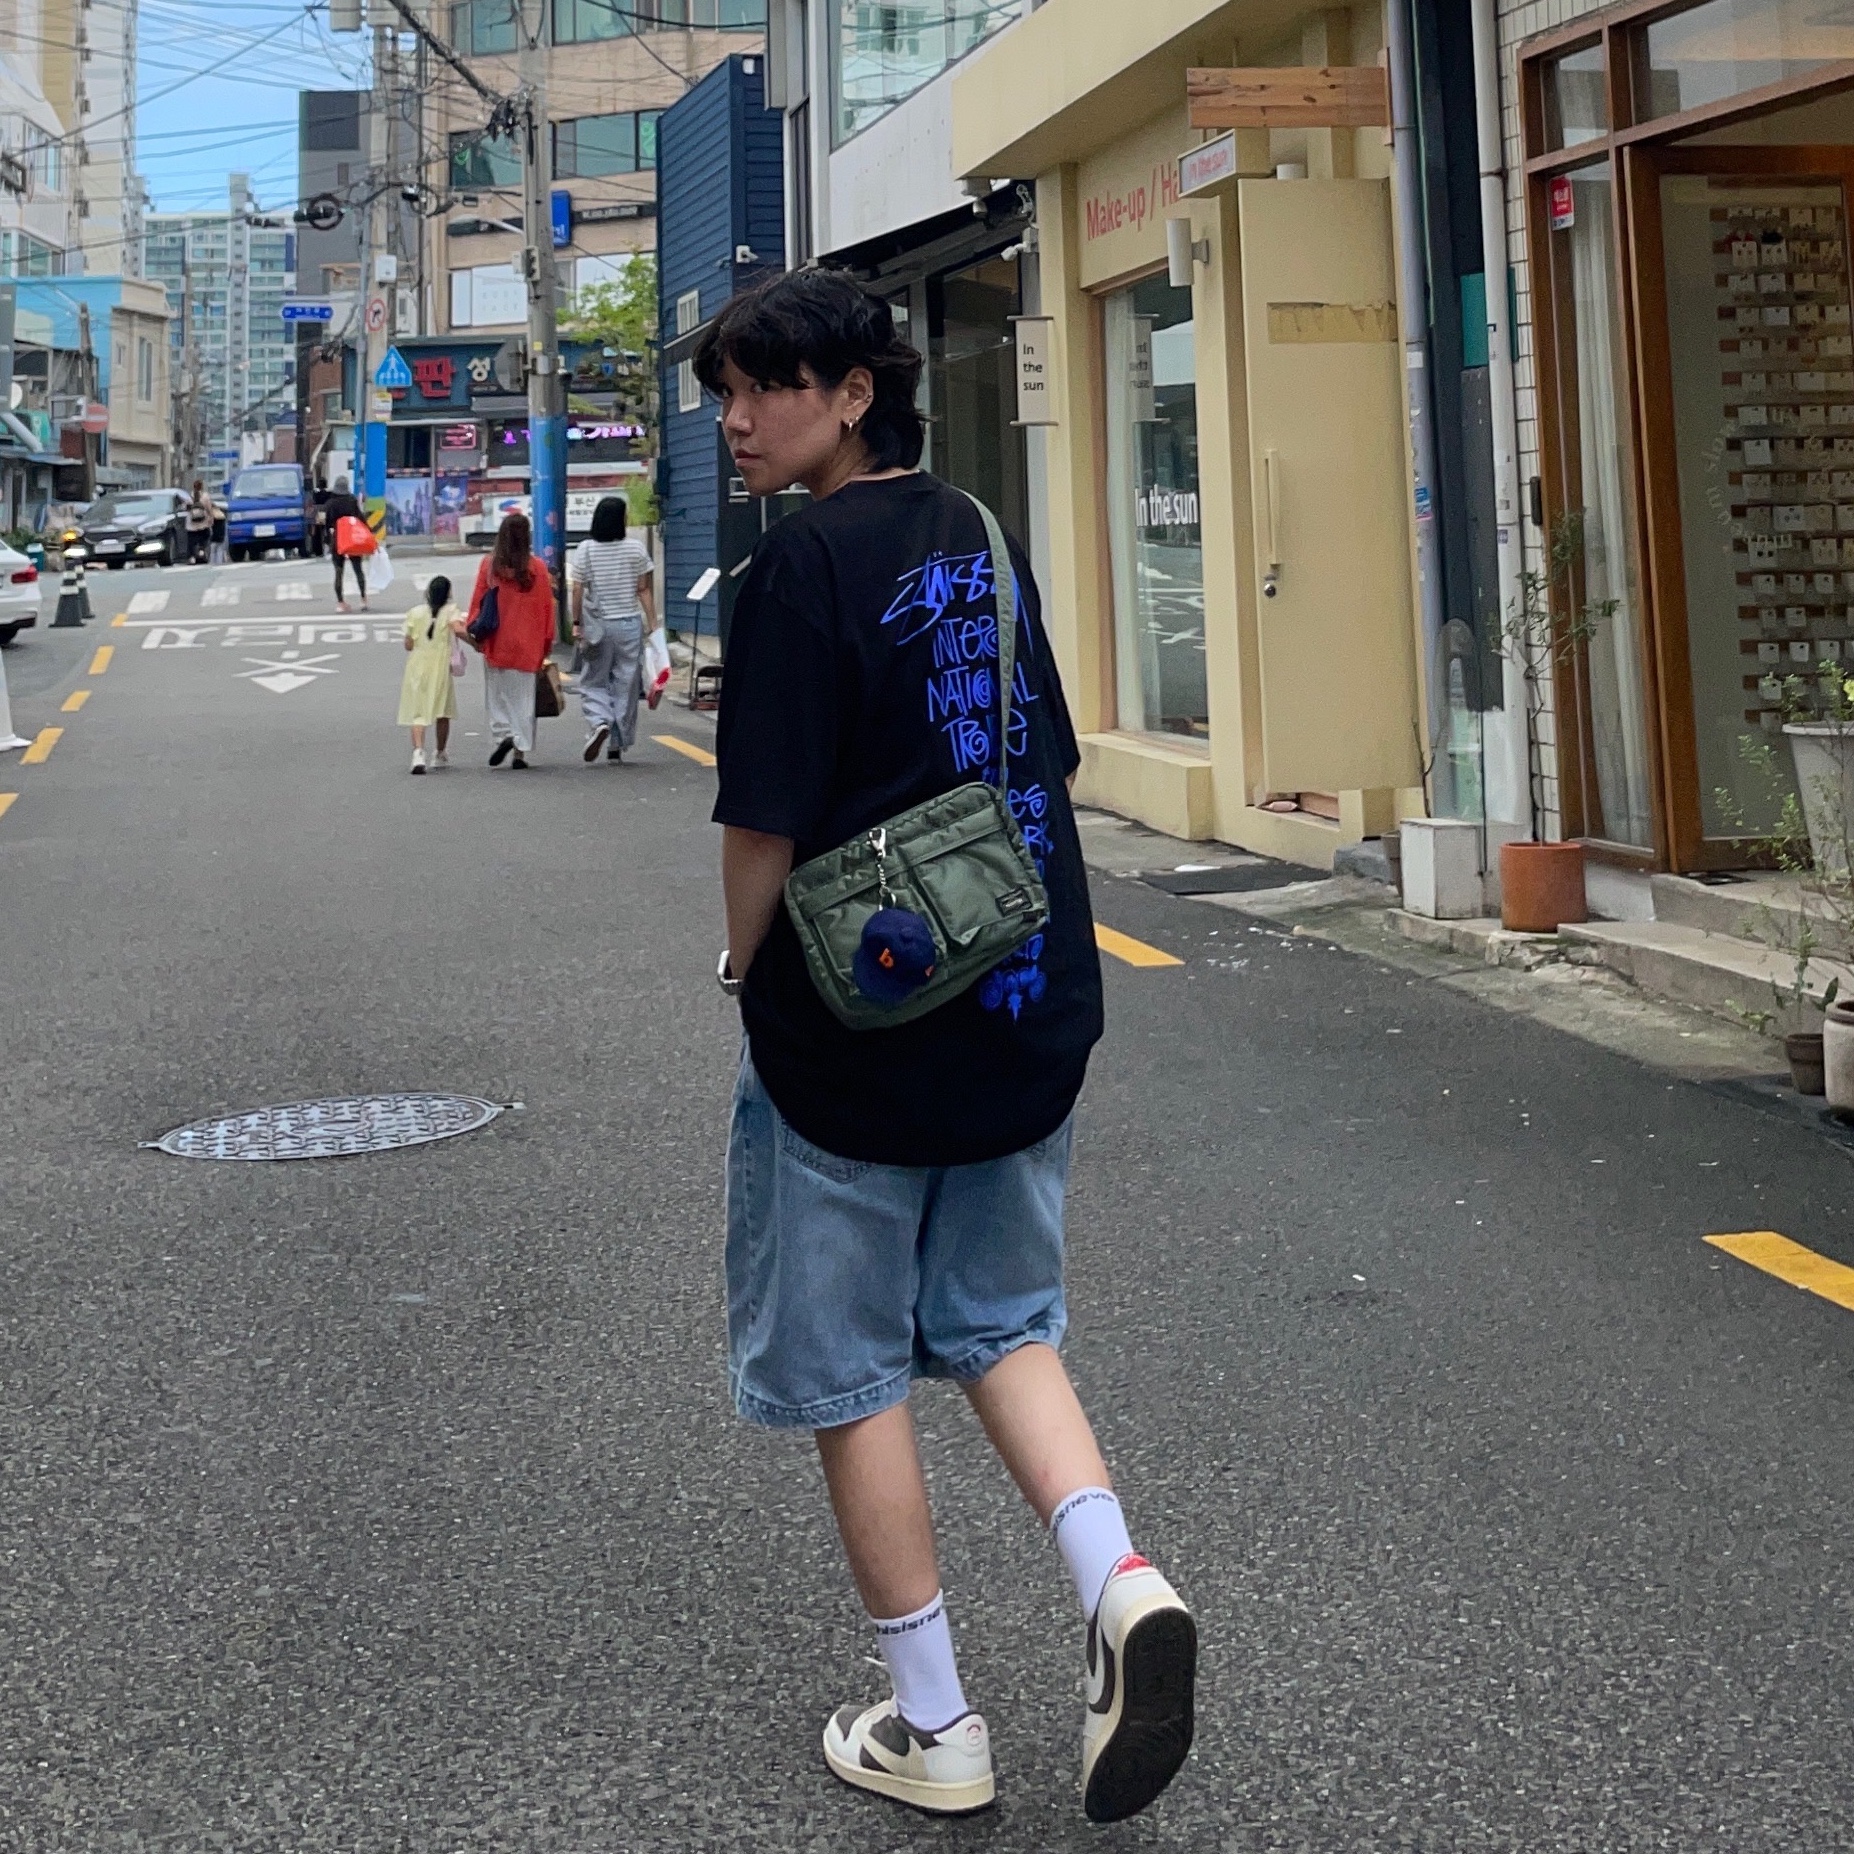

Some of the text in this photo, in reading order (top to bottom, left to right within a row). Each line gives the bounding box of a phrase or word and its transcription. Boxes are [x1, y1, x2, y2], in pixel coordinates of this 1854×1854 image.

[1086, 187, 1146, 242] Make-up
[1161, 161, 1178, 208] Ha
[1023, 344, 1034, 355] In
[1023, 361, 1043, 373] the
[1023, 382, 1044, 391] sun
[1135, 483, 1198, 527] In the sun
